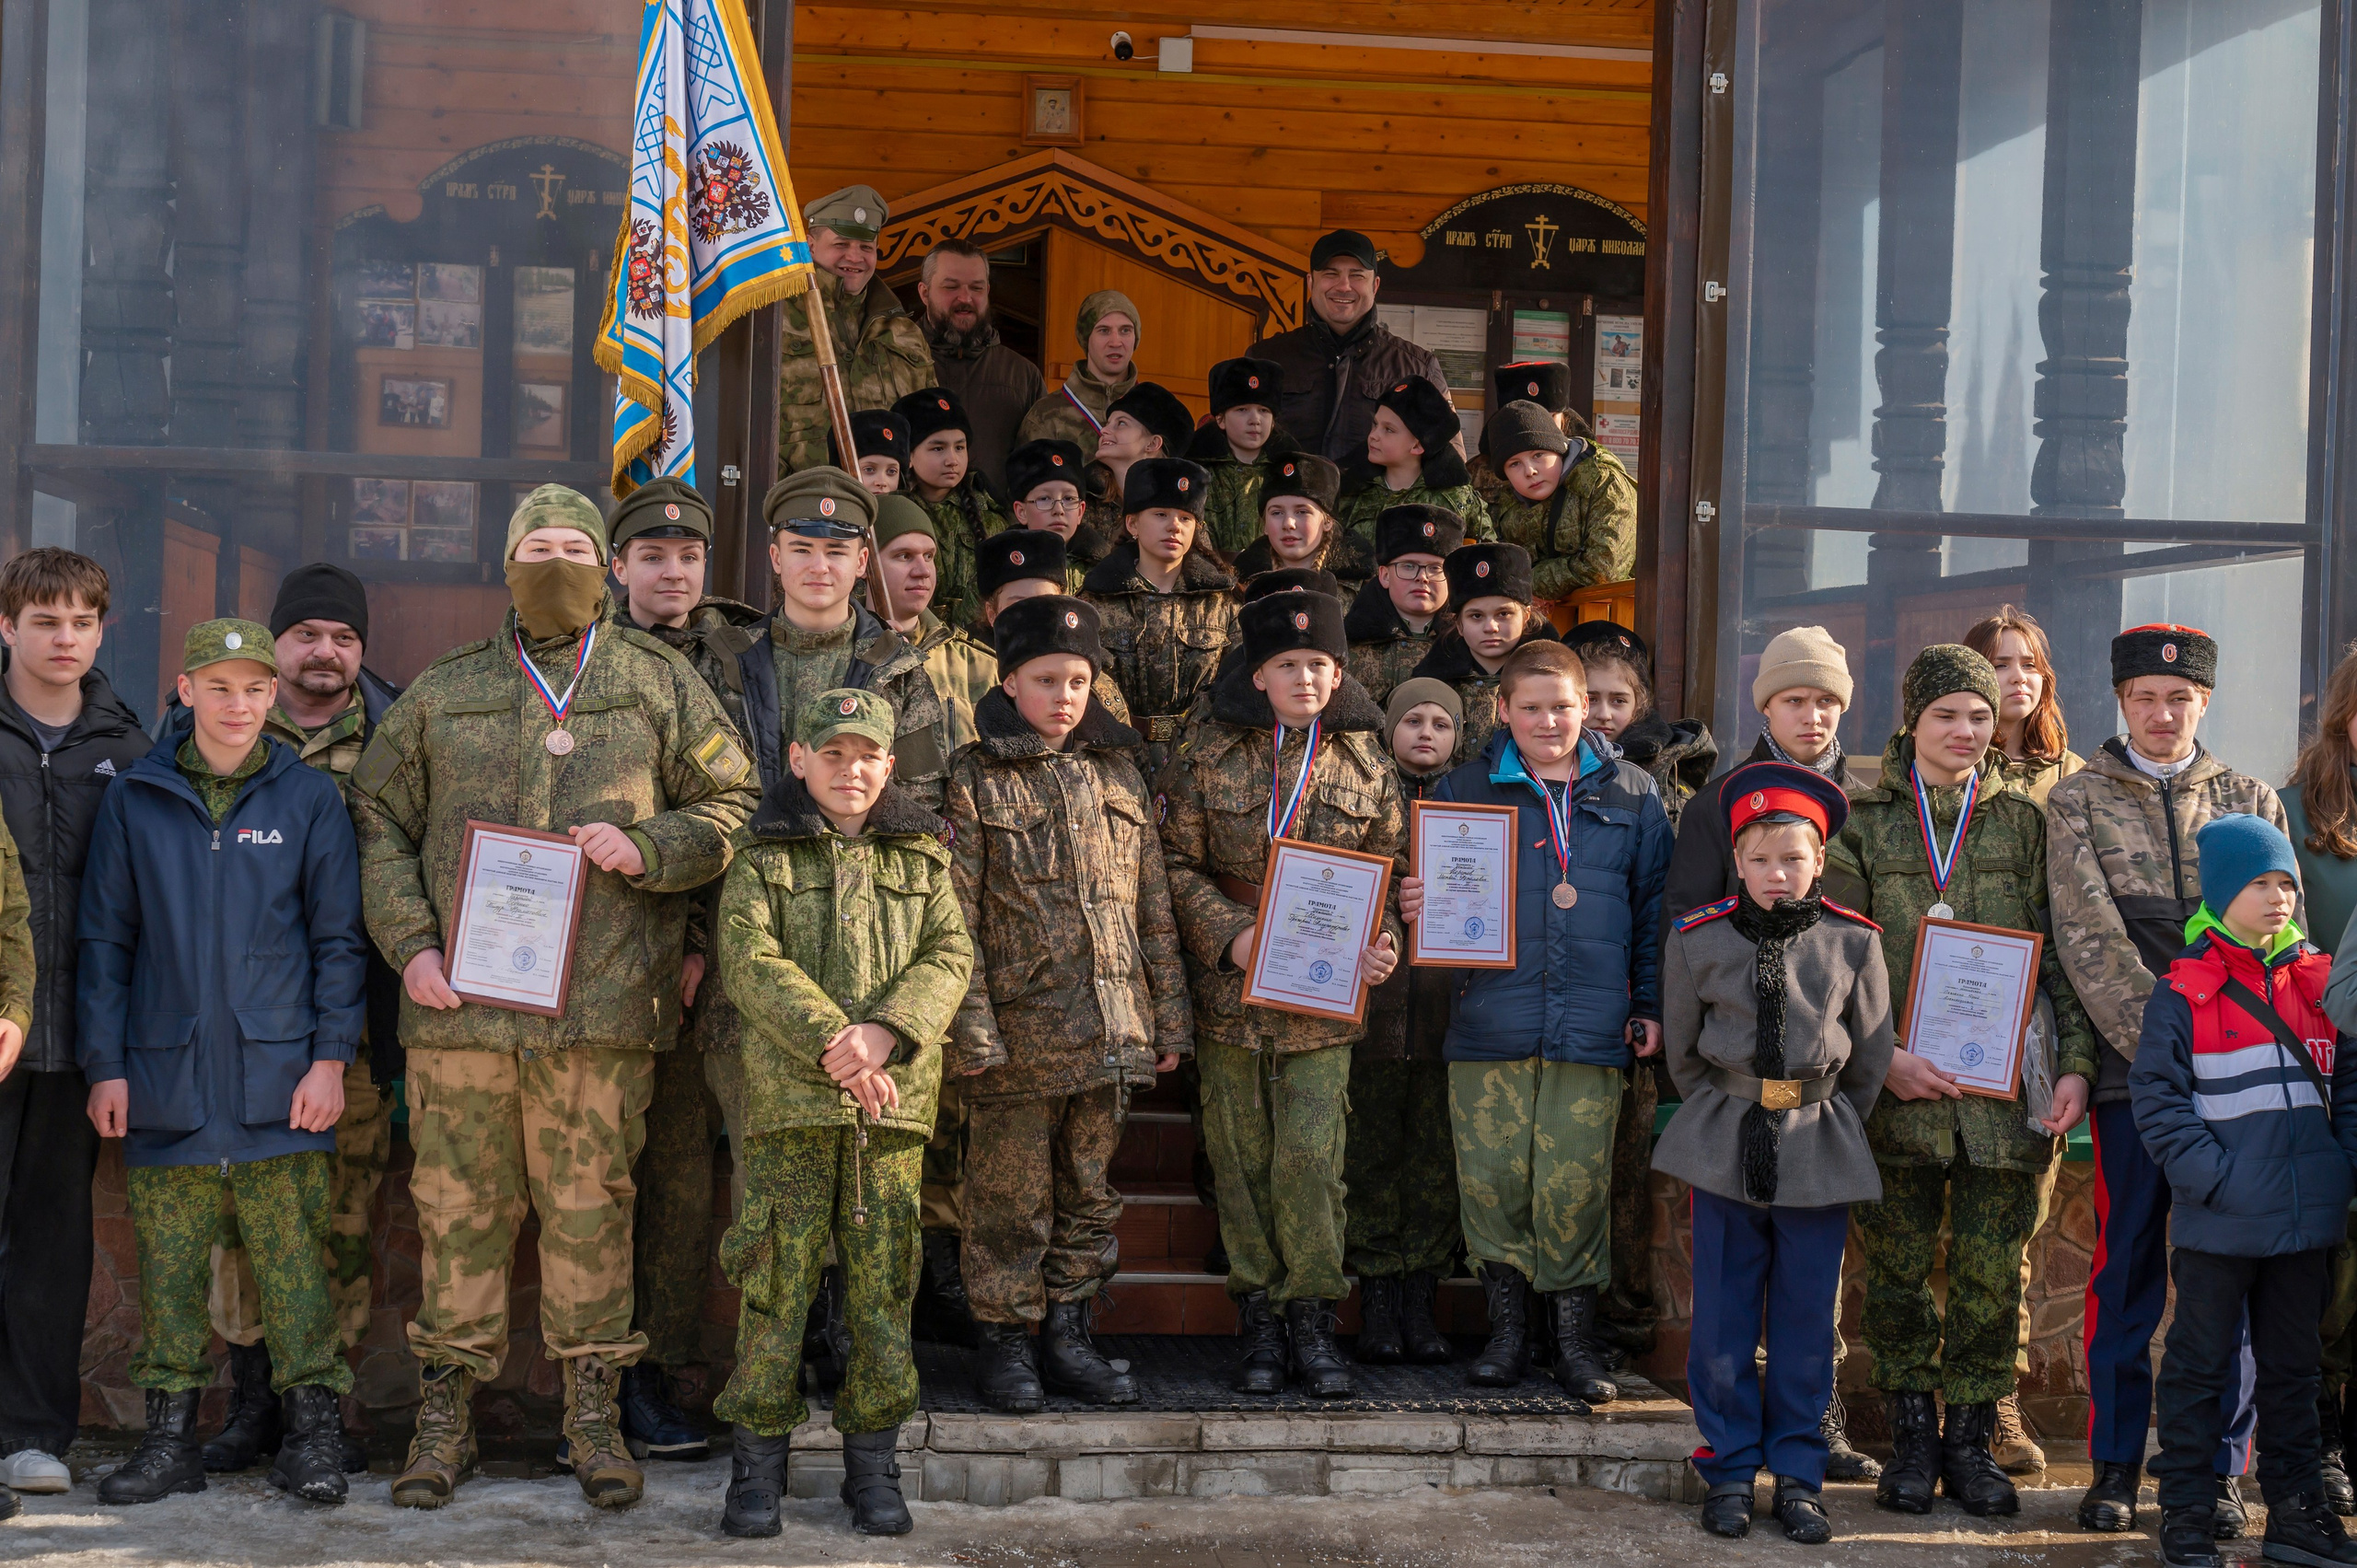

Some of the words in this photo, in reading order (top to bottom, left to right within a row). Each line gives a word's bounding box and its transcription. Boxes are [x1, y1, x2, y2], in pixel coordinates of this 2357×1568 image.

[238, 829, 283, 844] FILA
[505, 885, 535, 895] ГРАМОТА
[1308, 900, 1336, 910] ГРАМОТА
[1958, 978, 1987, 988] ГРАМОТА
